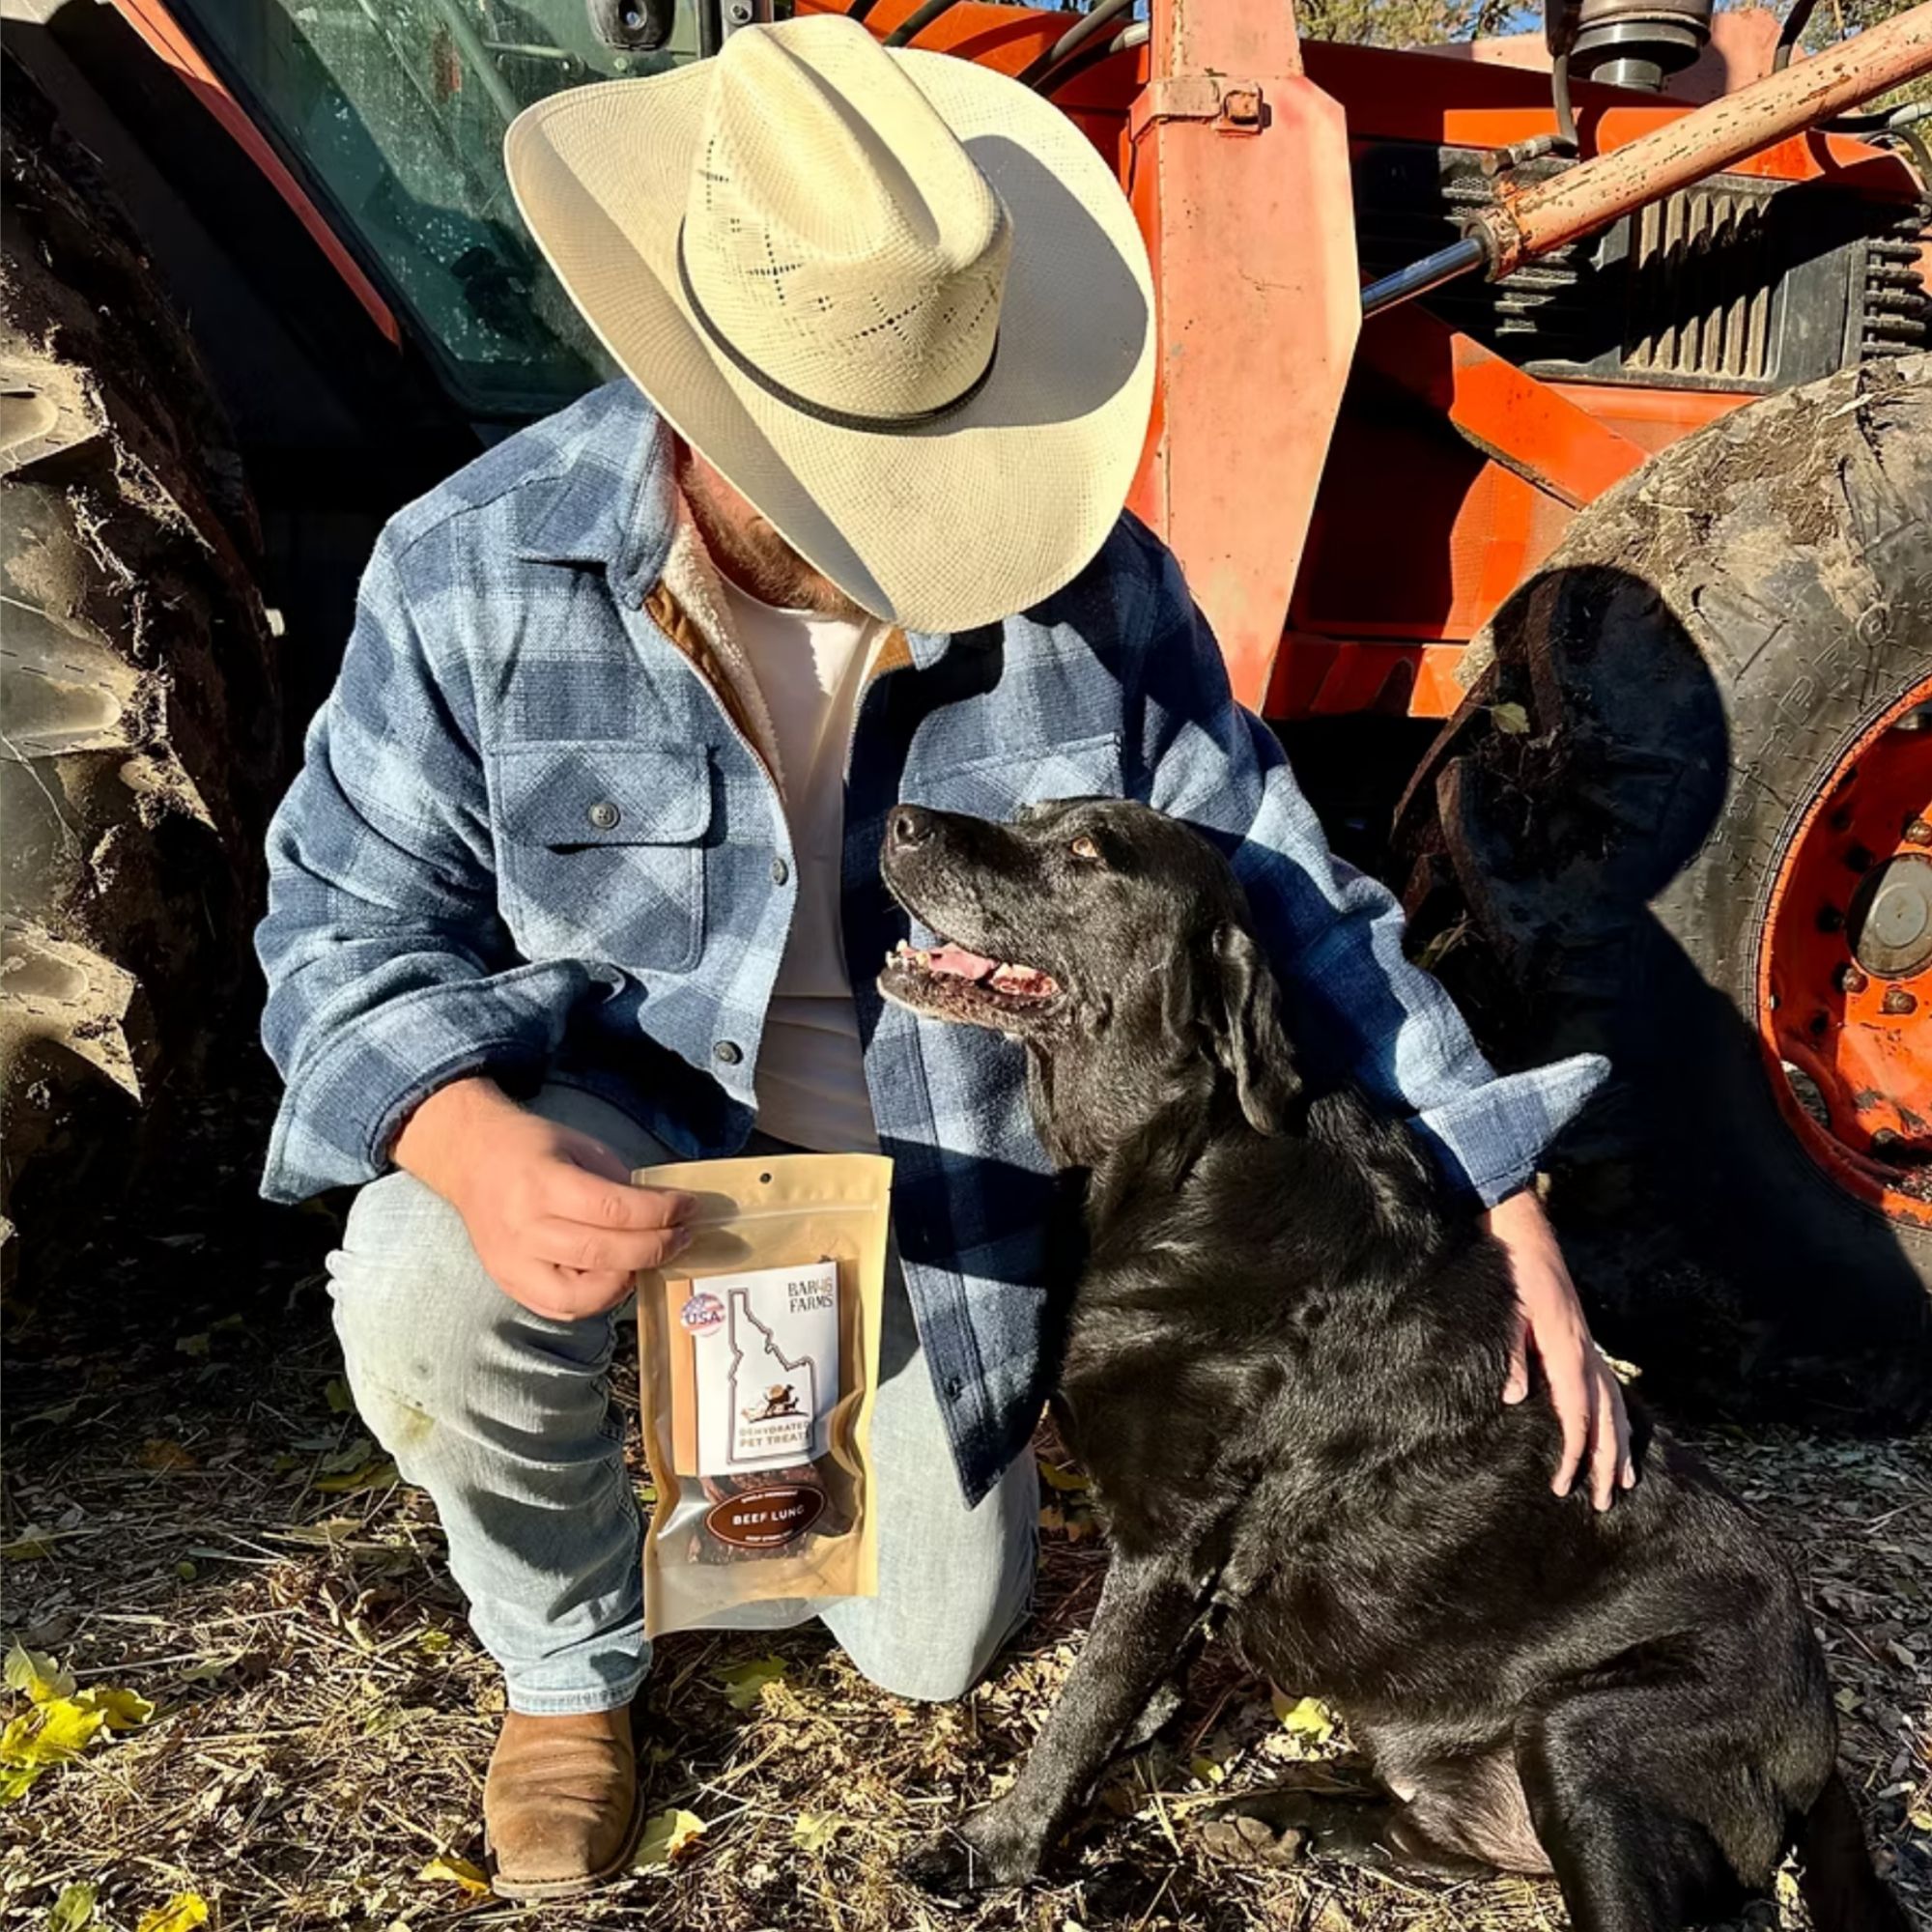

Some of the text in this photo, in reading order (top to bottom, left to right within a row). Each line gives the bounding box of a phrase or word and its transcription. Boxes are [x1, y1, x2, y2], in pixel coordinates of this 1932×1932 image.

[790, 1294, 833, 1313] FARMS
[685, 1310, 721, 1324] USA
[740, 1437, 762, 1447] PET
[732, 1512, 768, 1525] BEEF
